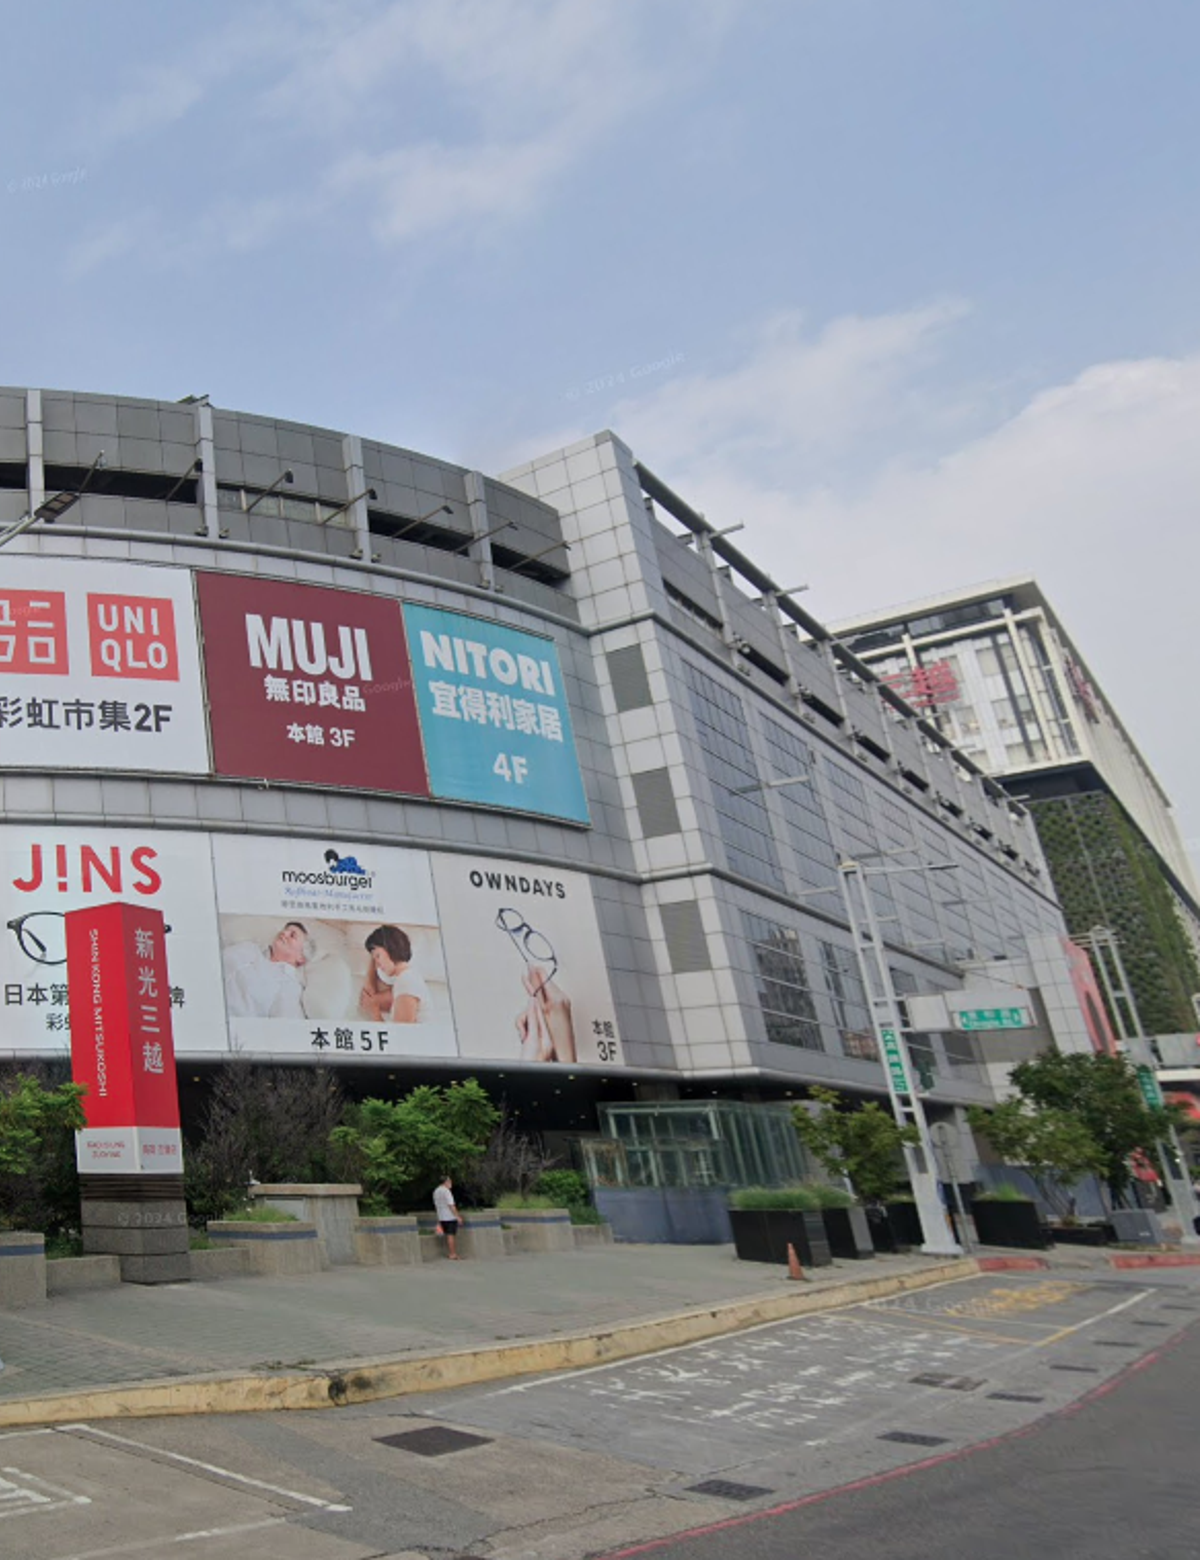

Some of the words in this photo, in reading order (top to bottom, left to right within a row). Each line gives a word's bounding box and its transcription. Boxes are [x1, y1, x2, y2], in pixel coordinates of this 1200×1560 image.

[97, 604, 160, 635] UNI
[100, 639, 168, 672] QLO
[245, 612, 373, 681] MUJI
[420, 629, 557, 696] NITORI
[263, 674, 366, 712] 無印良品
[428, 681, 564, 743] 宜得利家居
[286, 723, 325, 746] 本館
[330, 728, 356, 748] 3F
[492, 753, 528, 784] 4F
[282, 870, 373, 891] moosburger
[469, 870, 567, 899] OWNDAYS
[134, 926, 164, 1074] 新光三越
[94, 1006, 107, 1097] MITSUKOSHI
[596, 1040, 617, 1062] 3F
